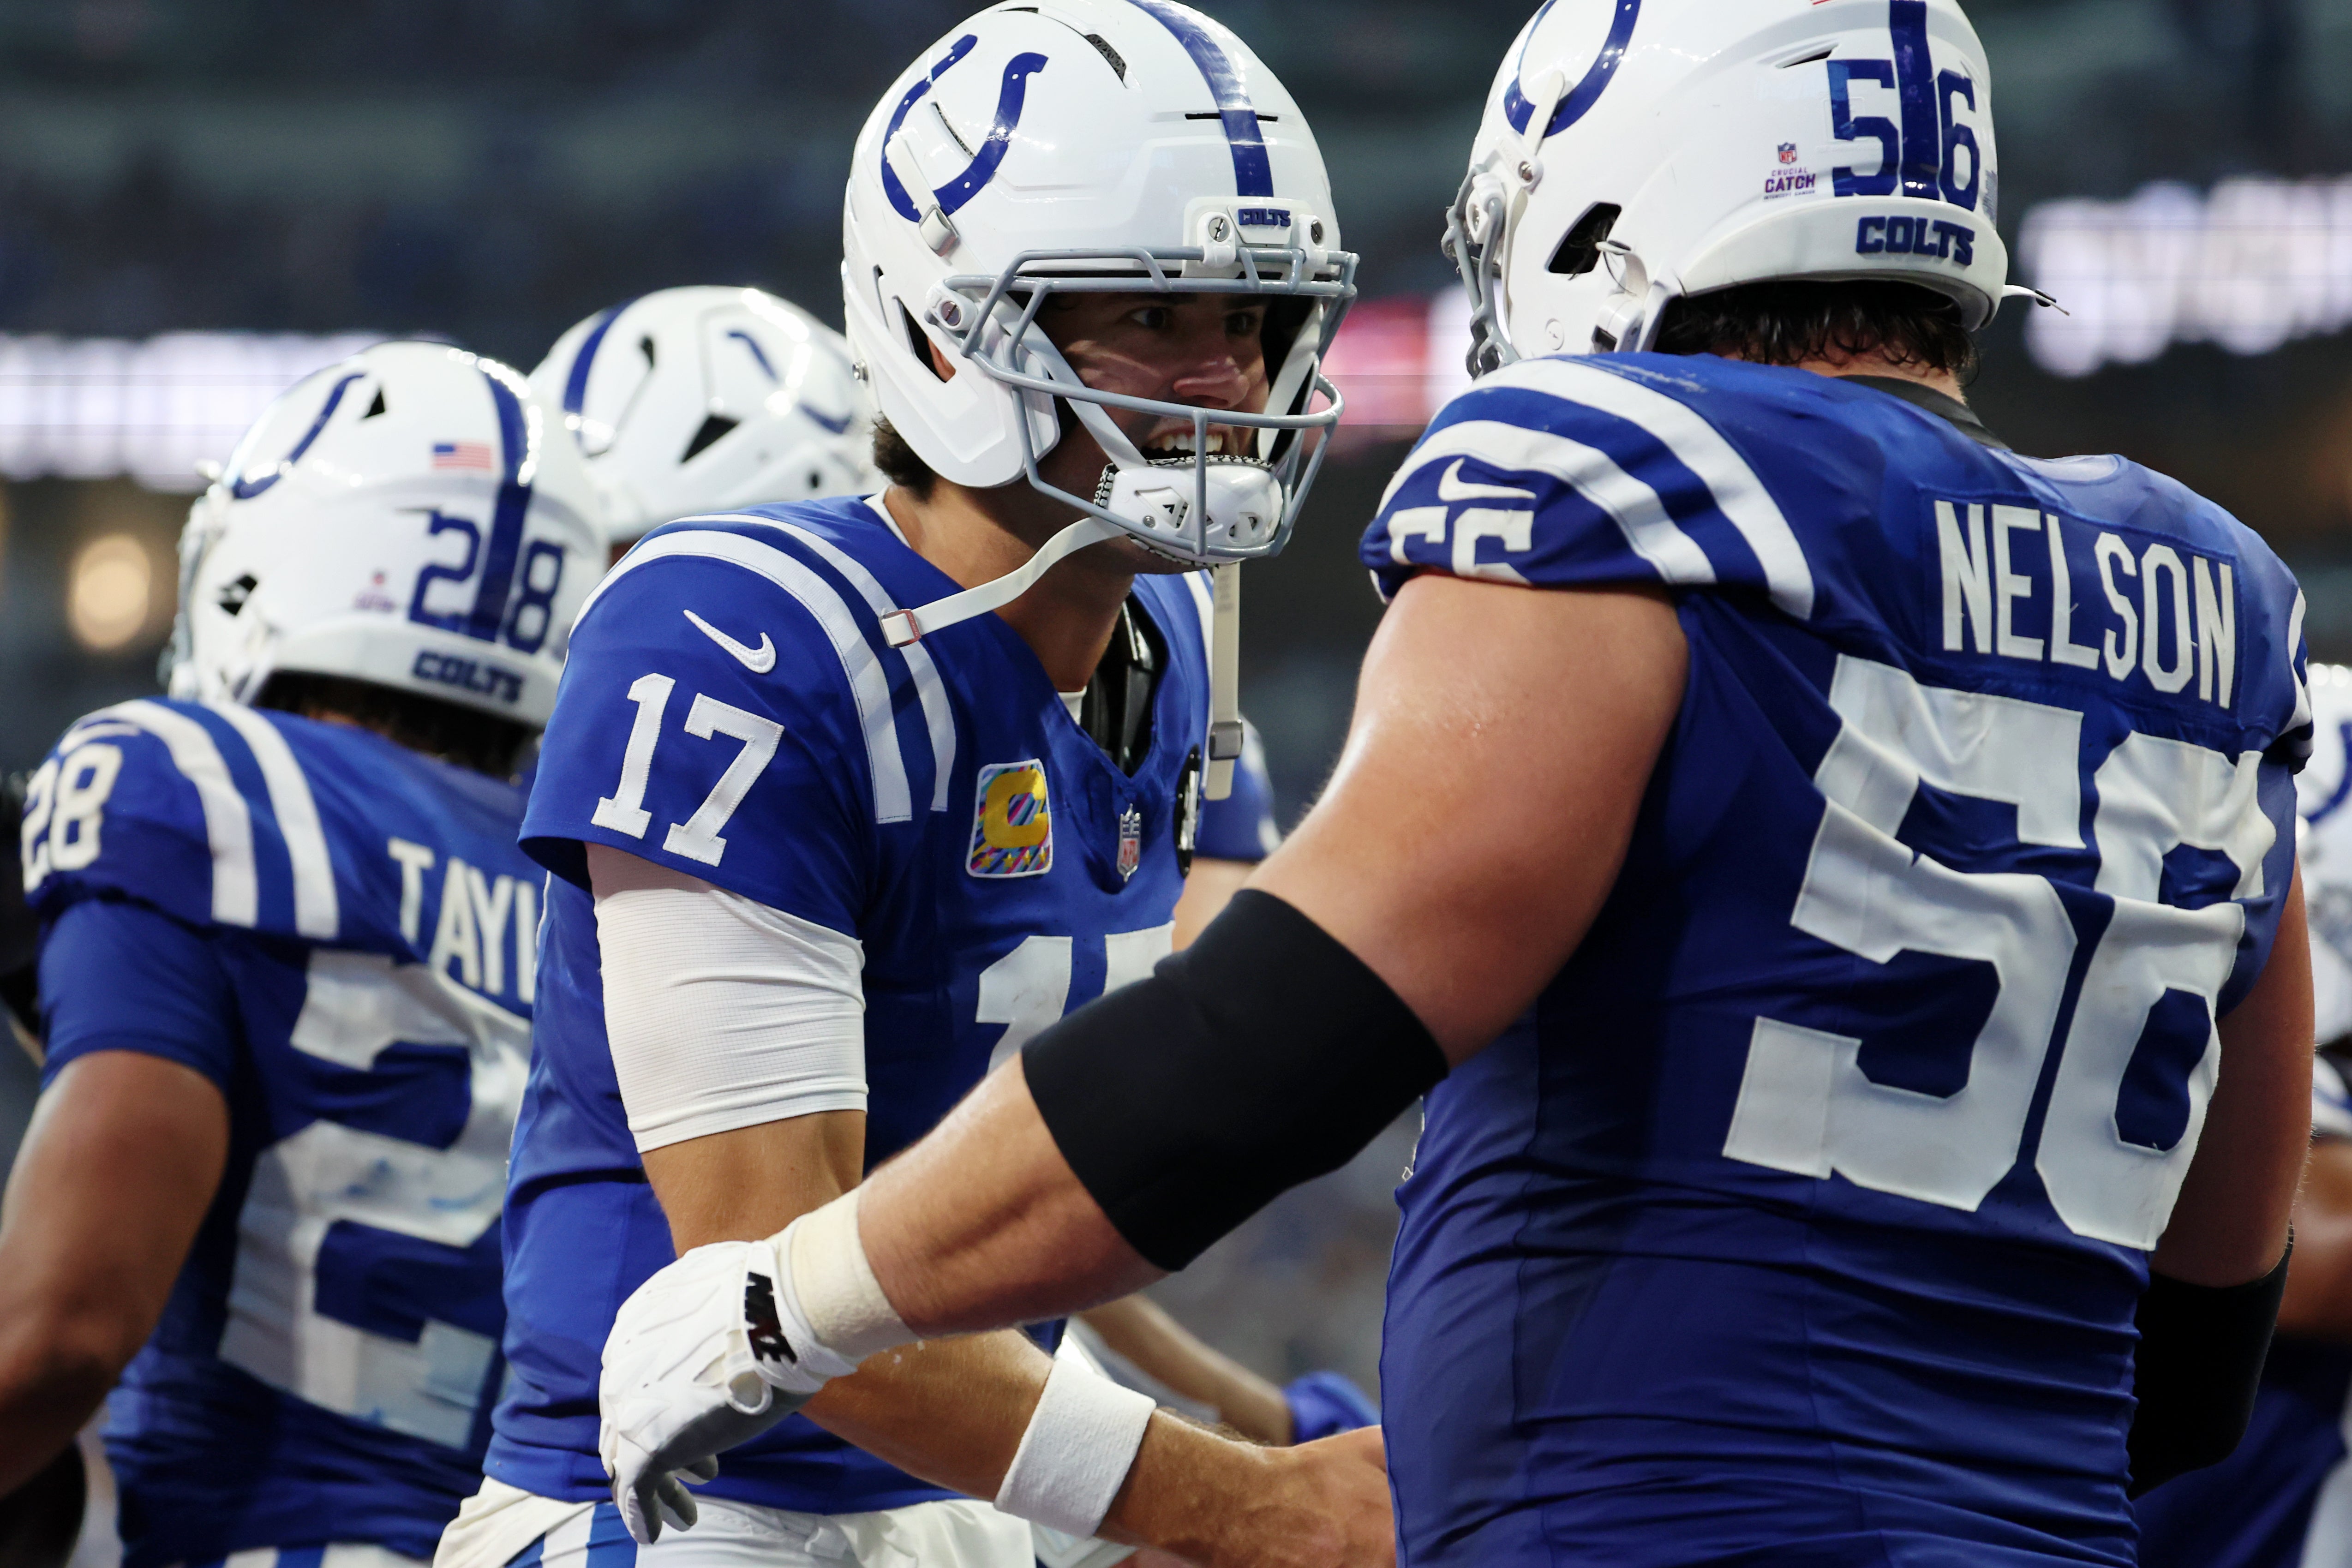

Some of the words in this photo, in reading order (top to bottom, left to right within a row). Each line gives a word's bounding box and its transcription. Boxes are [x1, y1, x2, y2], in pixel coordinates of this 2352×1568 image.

[1765, 174, 1816, 193] CATCH
[1771, 167, 1808, 176] CRUCIAL
[1826, 59, 1980, 211] 56
[1238, 208, 1291, 227] COLTS
[1855, 215, 1975, 266] COLTS
[407, 509, 564, 654] 28
[1934, 500, 2236, 710] NELSON
[412, 650, 525, 705] COLTS
[20, 741, 125, 895] 28
[591, 672, 784, 868] 17
[1722, 653, 2277, 1251] 56
